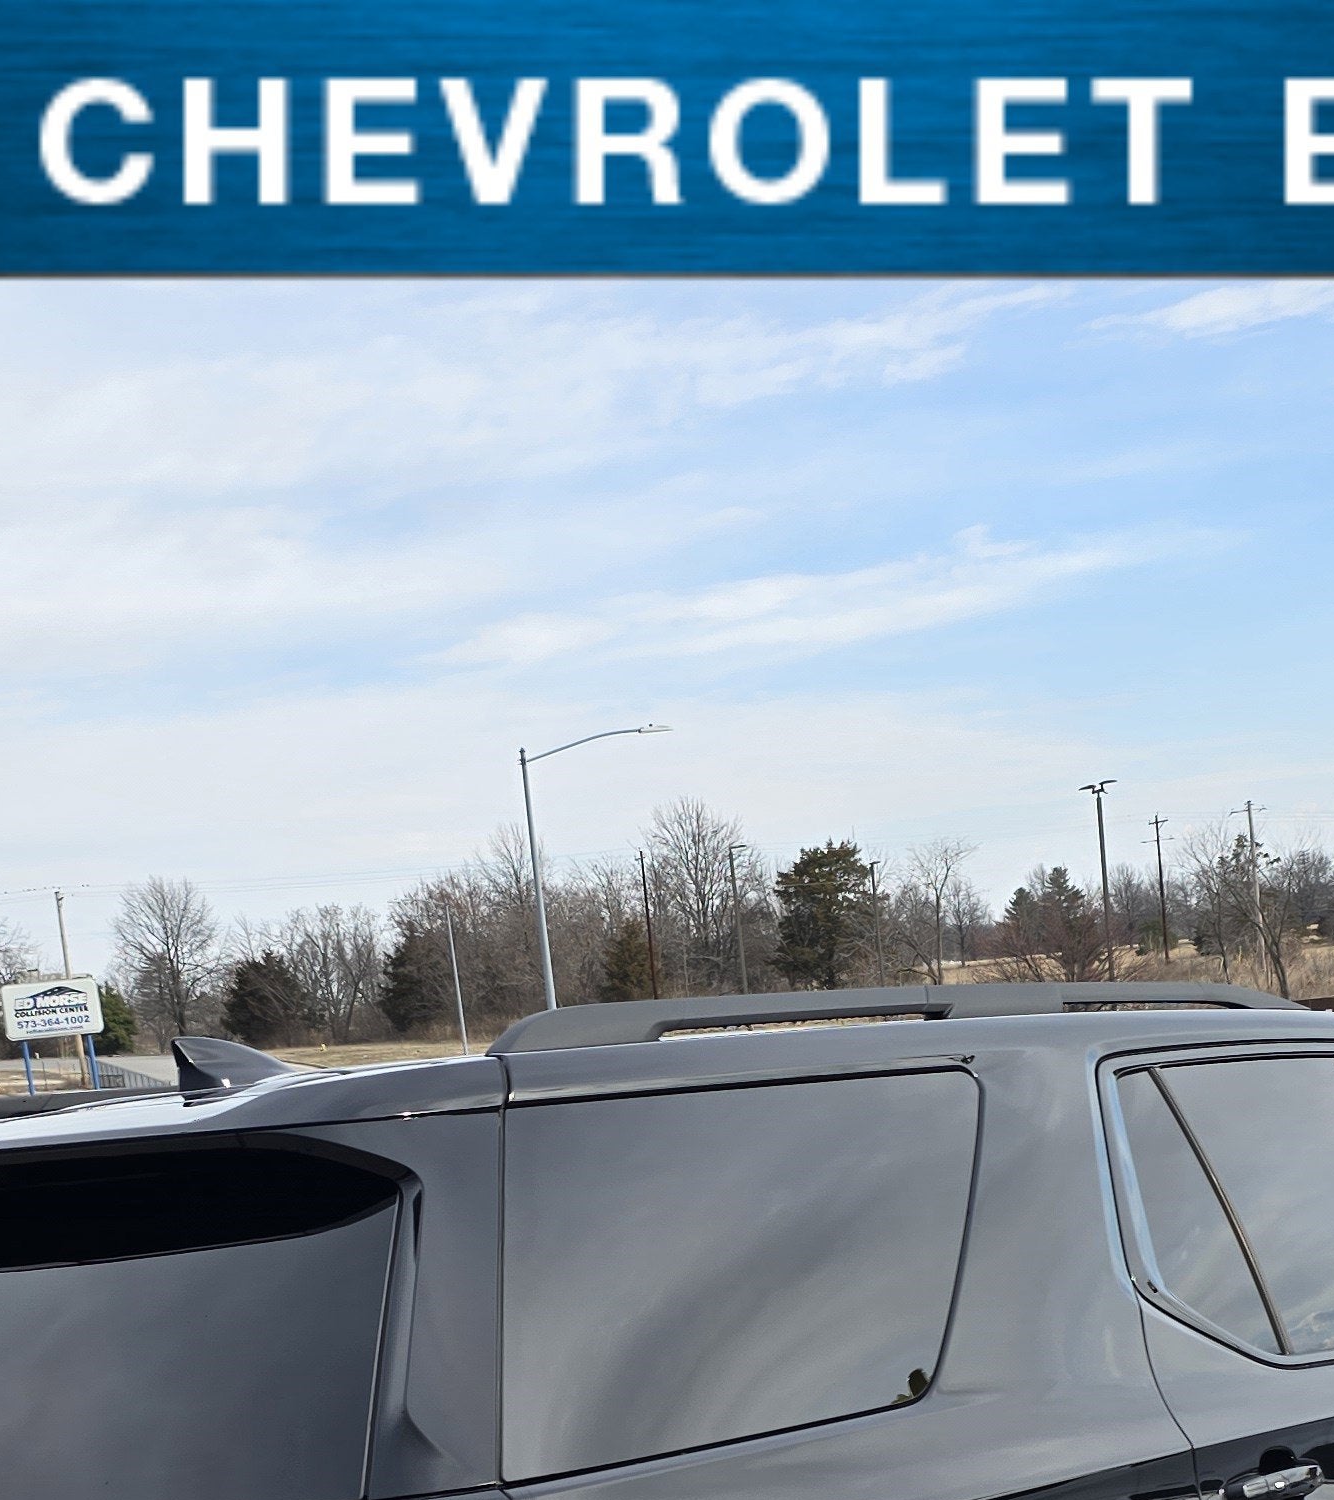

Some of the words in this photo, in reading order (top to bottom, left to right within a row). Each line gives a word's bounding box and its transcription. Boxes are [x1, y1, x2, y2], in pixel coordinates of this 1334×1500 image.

[15, 997, 34, 1009] ED
[35, 992, 87, 1008] MORSE
[14, 1008, 57, 1018] COLLISION
[59, 1005, 89, 1014] CENTER
[17, 1015, 90, 1029] 573-364-1002
